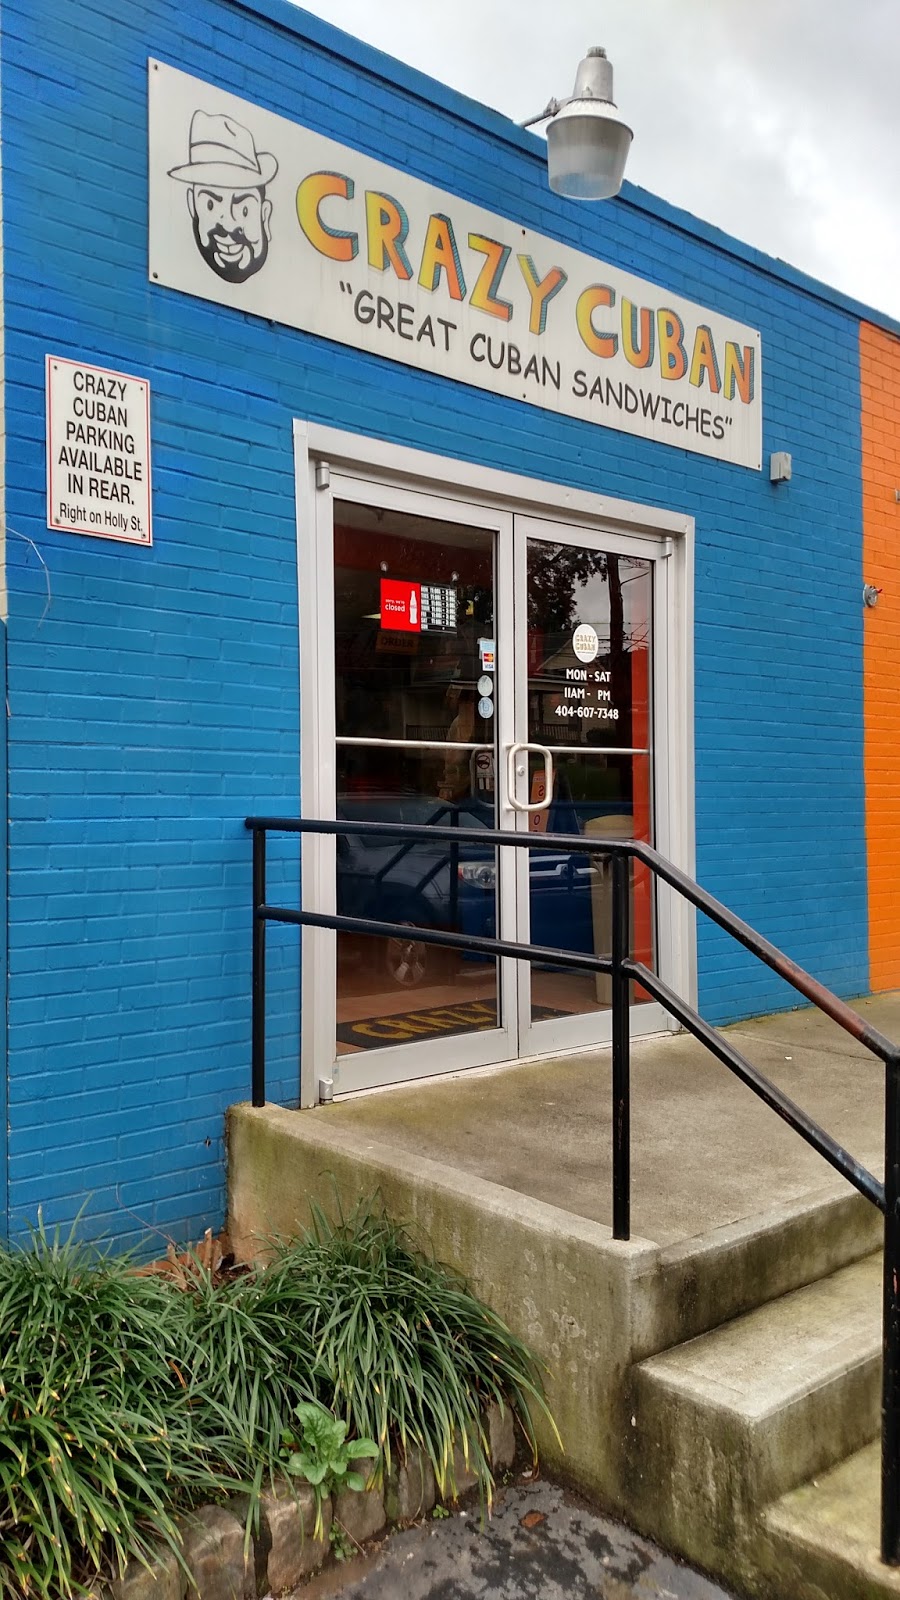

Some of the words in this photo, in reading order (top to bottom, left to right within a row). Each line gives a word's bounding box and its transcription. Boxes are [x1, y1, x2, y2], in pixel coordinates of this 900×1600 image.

[296, 170, 568, 335] CRAZY
[576, 283, 755, 404] CUBAN
[470, 333, 562, 390] CUBAN
[73, 371, 127, 401] CRAZY
[73, 396, 128, 427] CUBAN
[66, 421, 135, 454] PARKING
[58, 446, 142, 481] AVAILABLE
[68, 473, 83, 495] IN
[89, 478, 135, 505] REAR.
[59, 503, 87, 523] Right
[89, 512, 102, 524] on
[104, 510, 128, 532] Holly
[130, 517, 143, 532] St.
[385, 603, 406, 612] closed
[597, 690, 611, 701] PM
[555, 705, 619, 720] 404-607-7348
